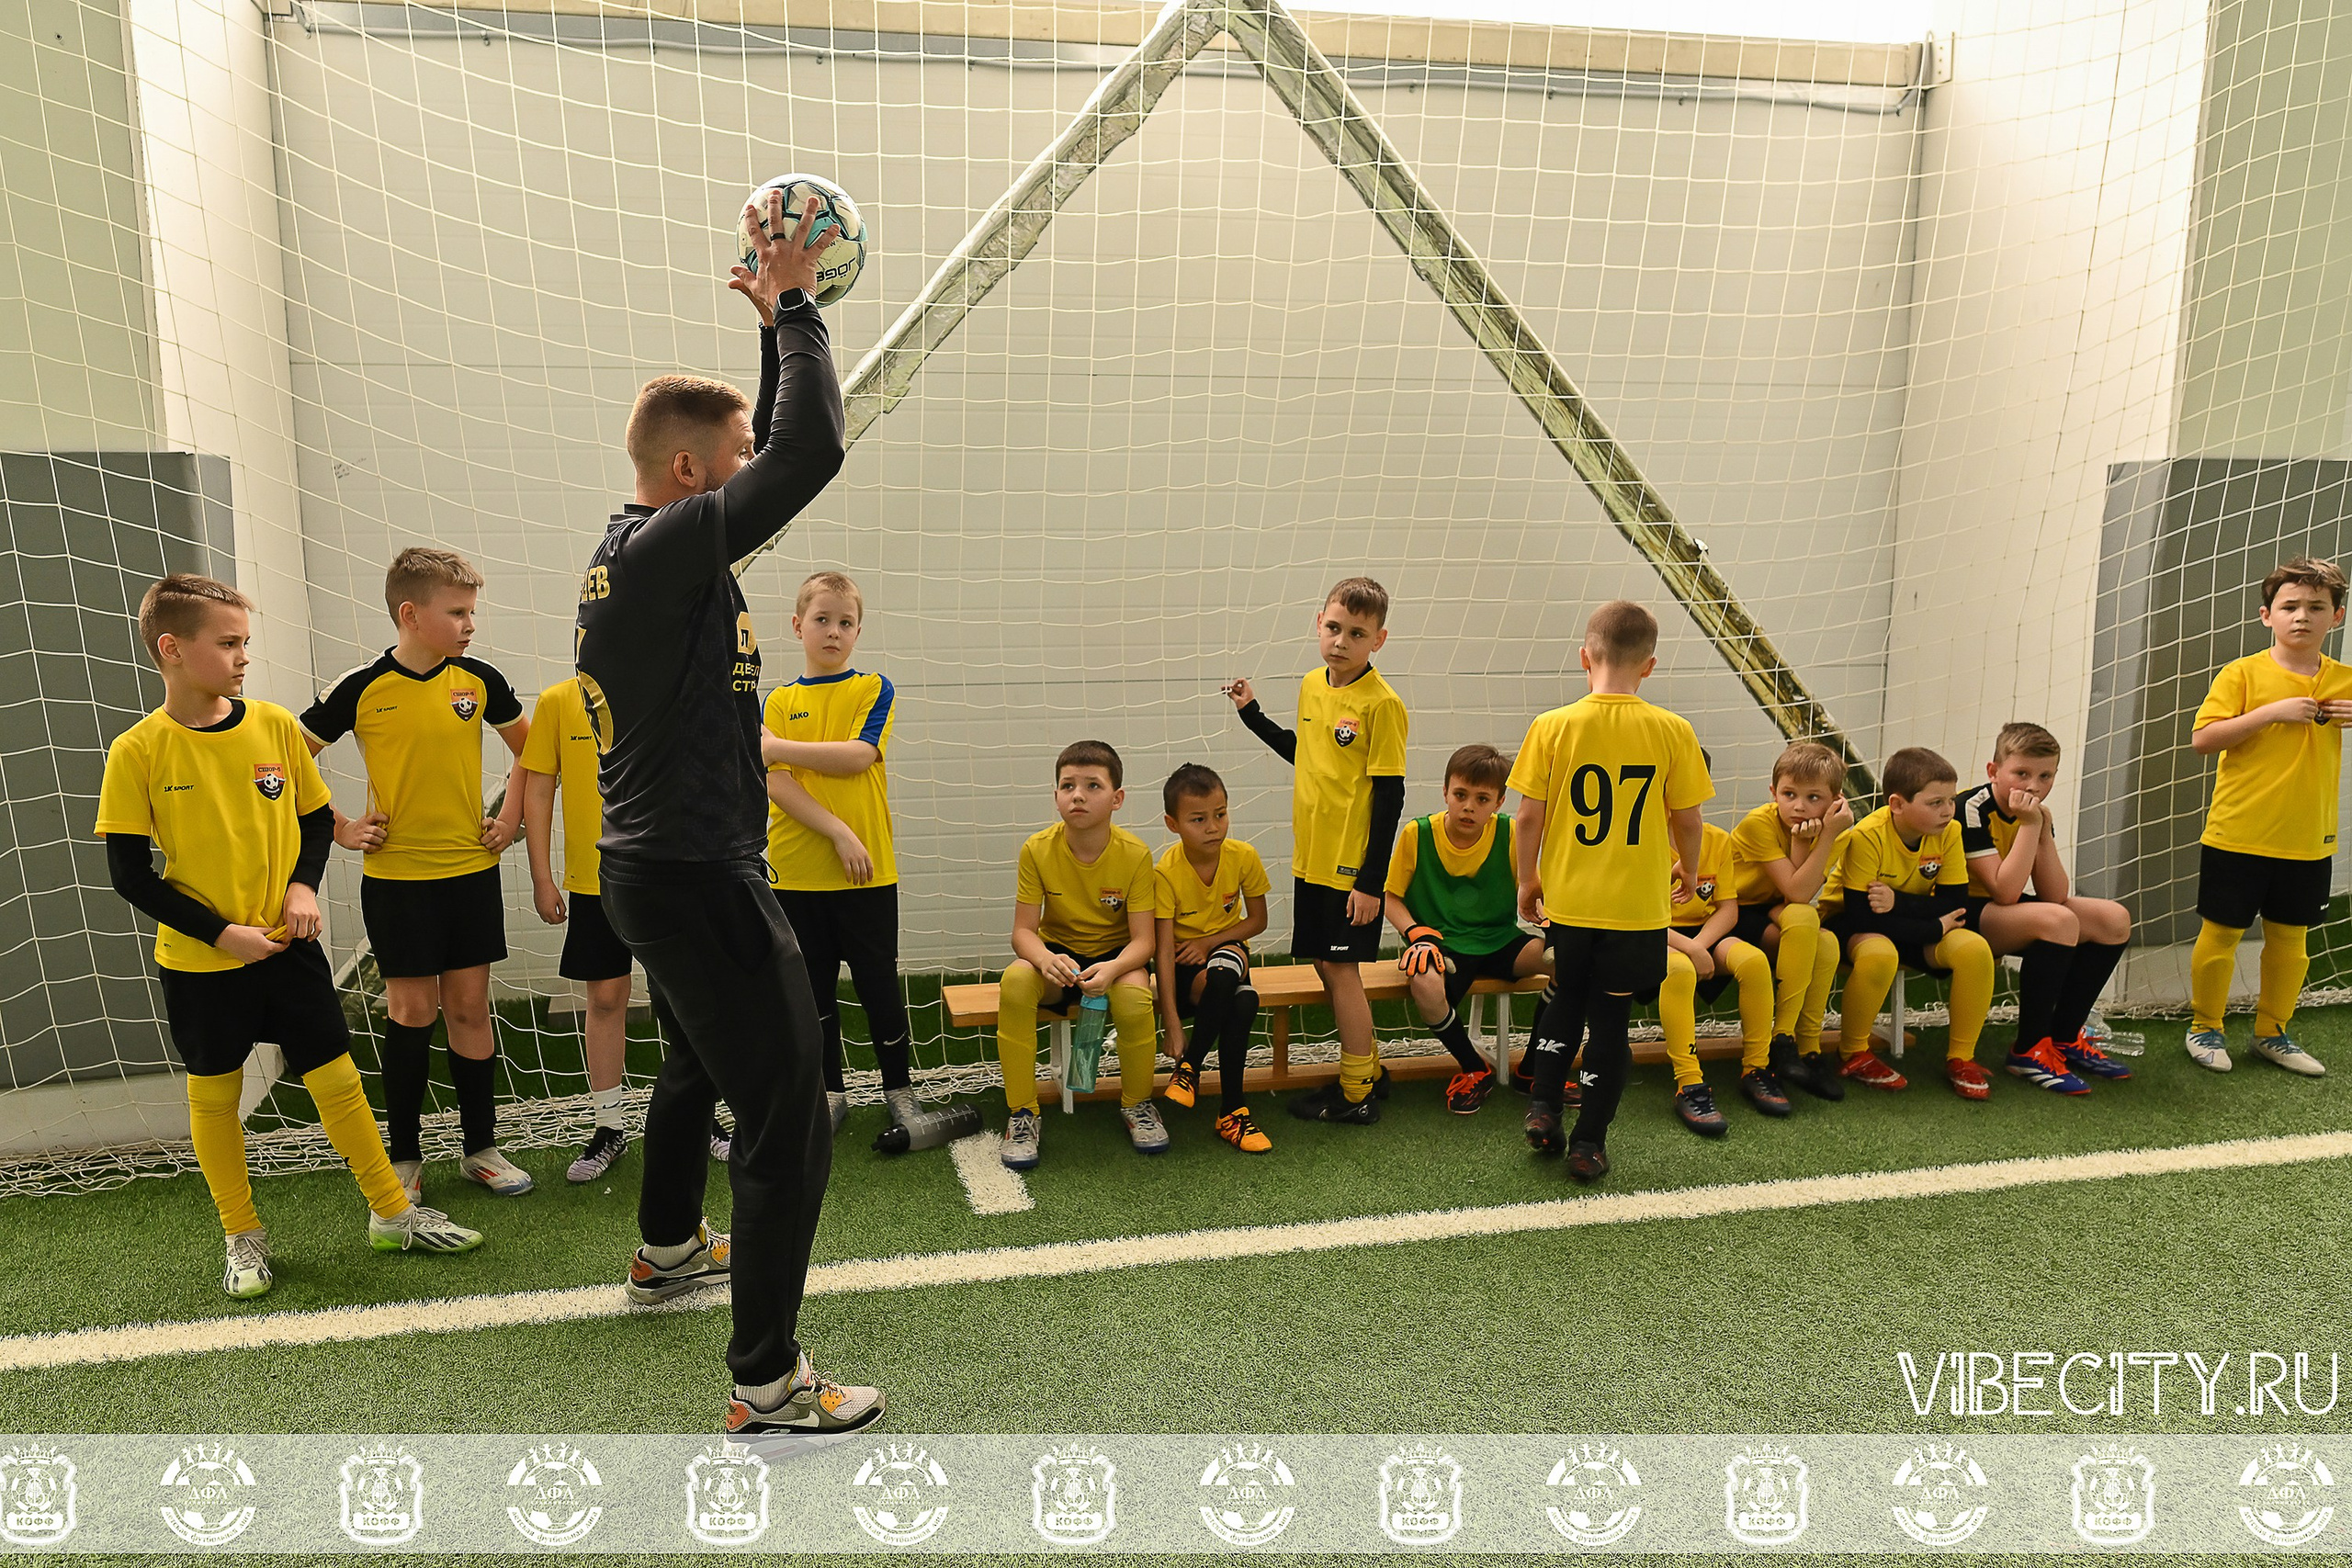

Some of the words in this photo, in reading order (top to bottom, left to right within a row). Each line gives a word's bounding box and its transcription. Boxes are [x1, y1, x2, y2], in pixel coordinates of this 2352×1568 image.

[816, 256, 856, 282] JÖGE
[789, 711, 809, 721] JAKO
[1570, 763, 1657, 846] 97
[1536, 1038, 1566, 1055] 2K
